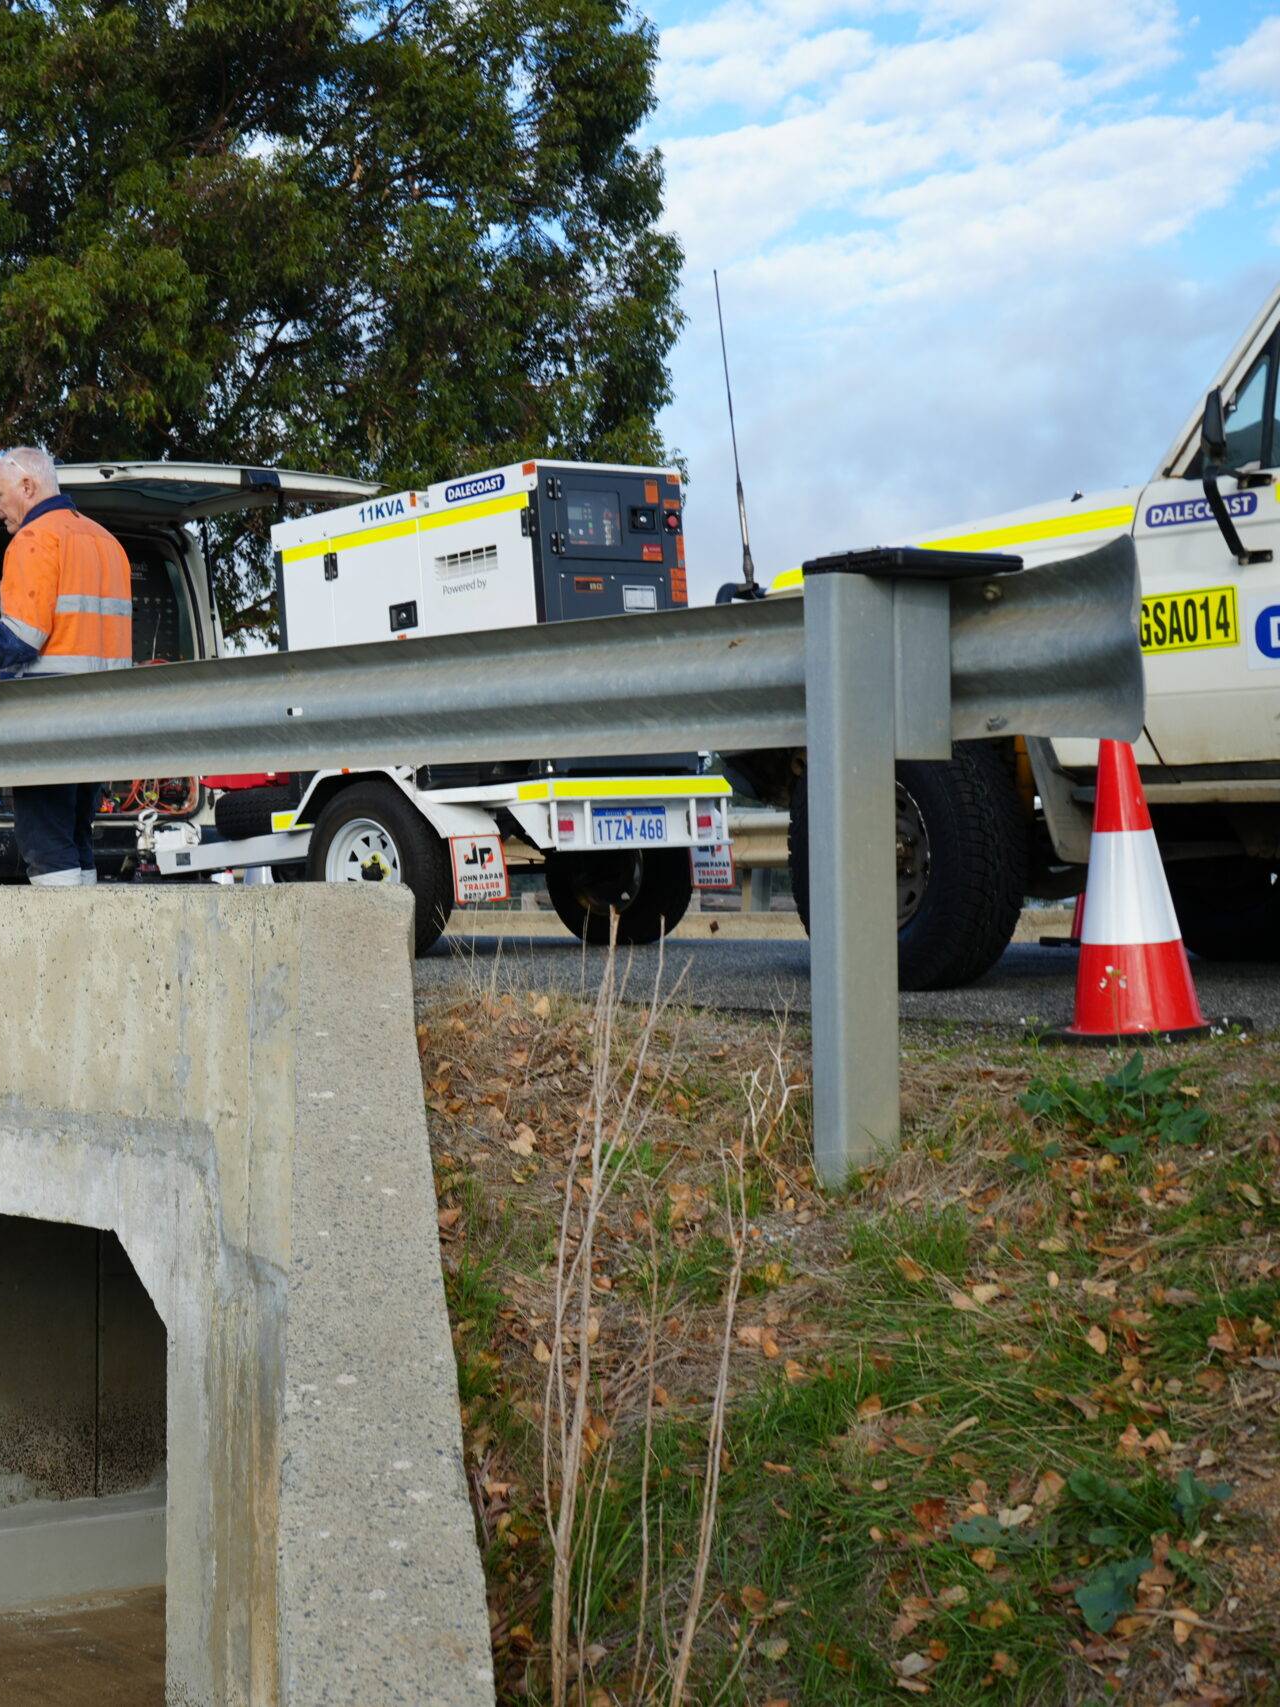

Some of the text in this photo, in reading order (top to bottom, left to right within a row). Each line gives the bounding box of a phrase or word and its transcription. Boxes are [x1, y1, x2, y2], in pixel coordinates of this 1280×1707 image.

[447, 475, 502, 501] DALECOAST
[359, 499, 405, 523] 11KVA
[442, 576, 488, 596] Powered by
[463, 881, 500, 891] TRAILERS
